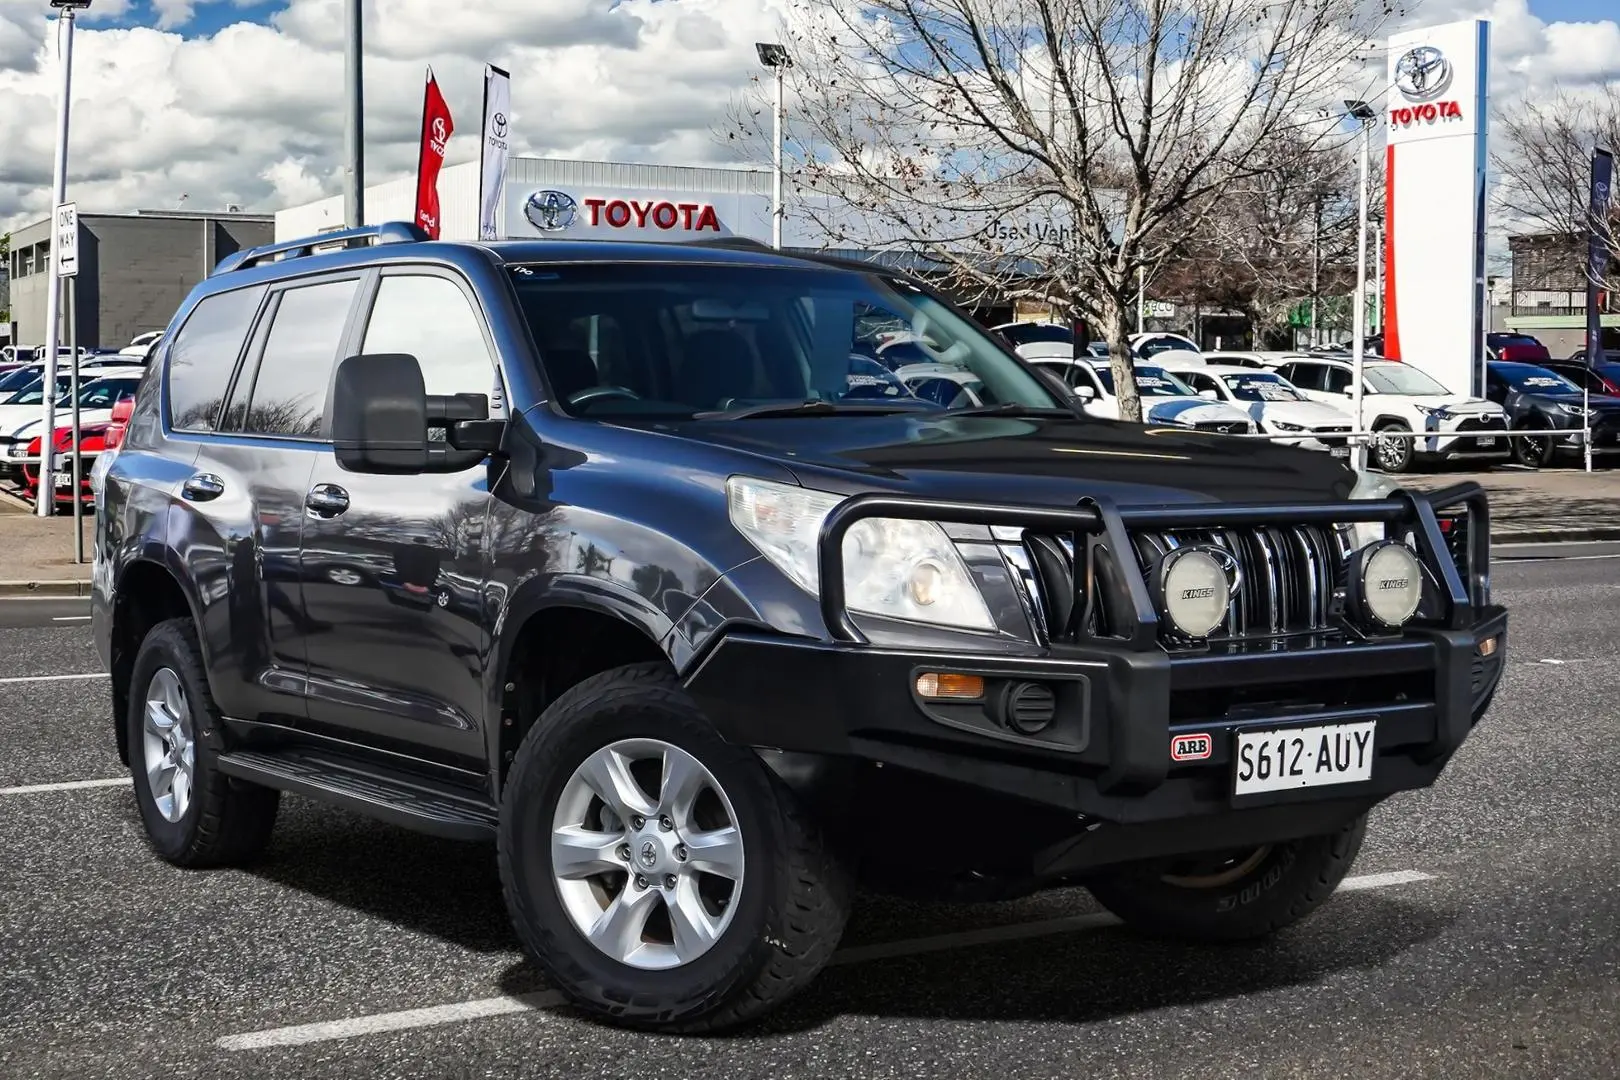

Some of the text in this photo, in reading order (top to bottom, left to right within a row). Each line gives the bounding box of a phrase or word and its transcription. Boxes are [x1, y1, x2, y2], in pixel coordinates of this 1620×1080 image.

[1390, 101, 1461, 124] TOYOTA
[488, 136, 508, 150] TOYOTA
[60, 209, 74, 227] ONE
[585, 199, 720, 232] TOYOTA
[985, 221, 1030, 239] Used
[60, 231, 75, 249] WAY
[1379, 578, 1409, 590] KINGS
[1182, 588, 1214, 599] KINGS
[1177, 739, 1208, 755] ARB
